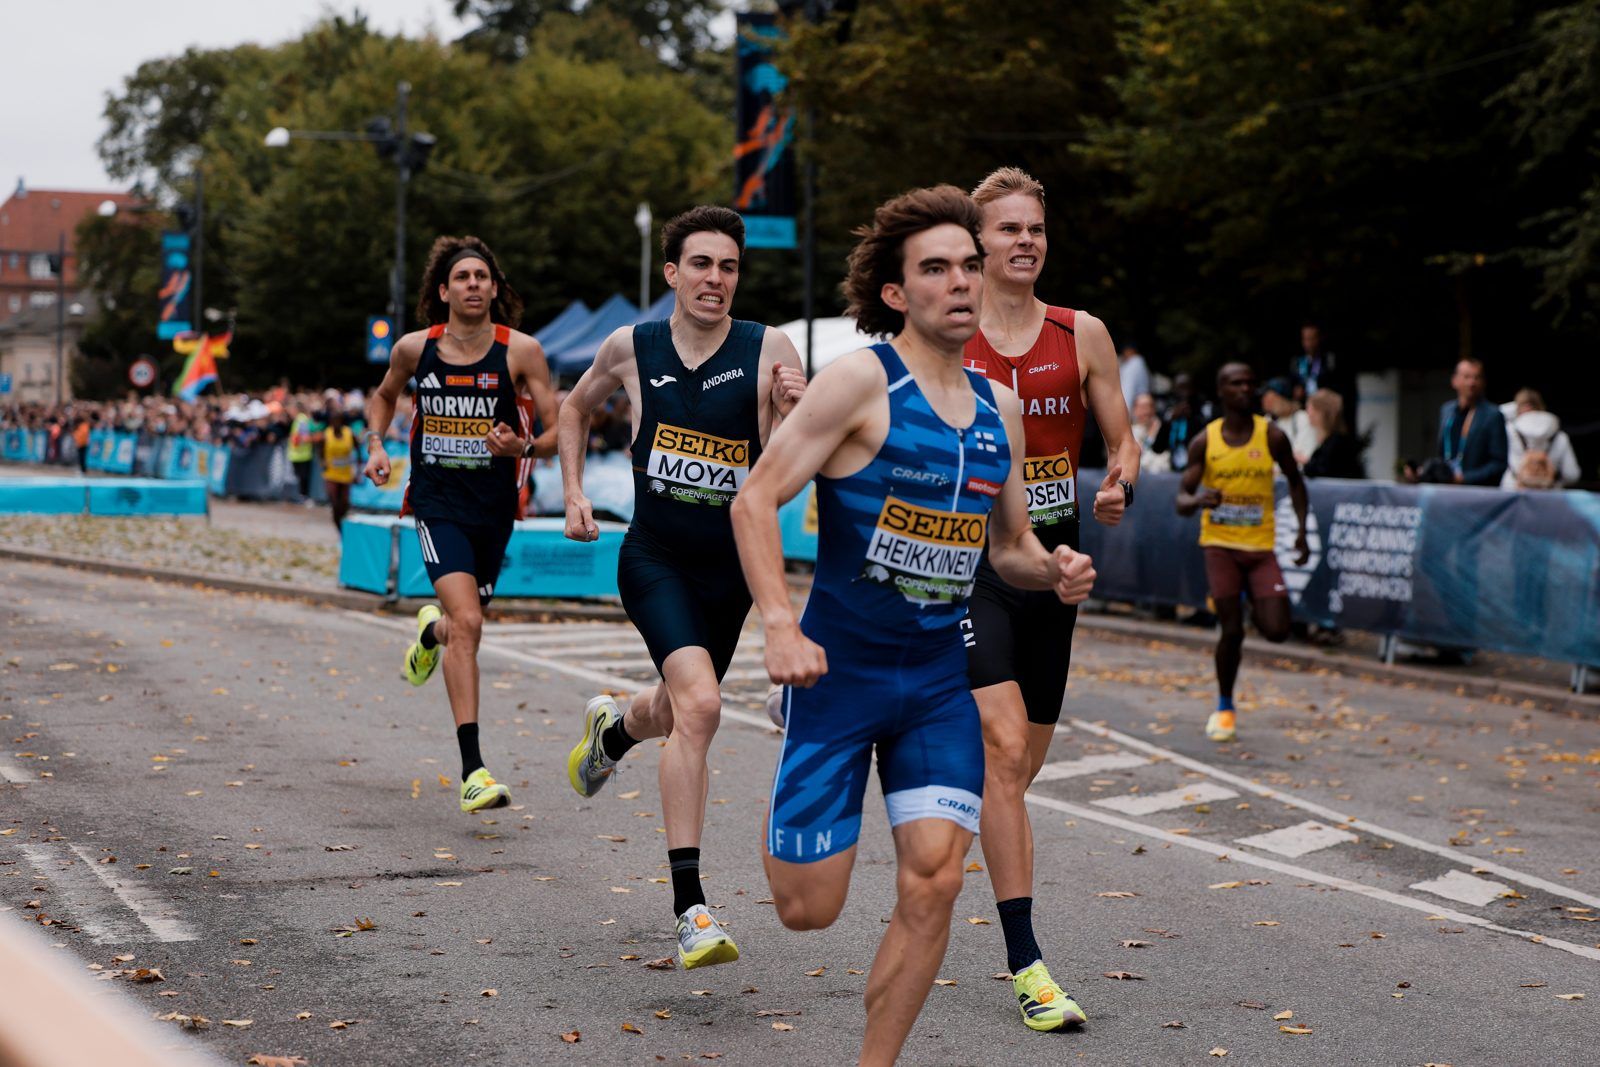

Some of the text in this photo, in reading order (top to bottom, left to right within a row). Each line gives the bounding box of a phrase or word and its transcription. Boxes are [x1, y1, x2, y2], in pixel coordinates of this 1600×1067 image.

[702, 368, 745, 391] ANDORRA
[1028, 364, 1052, 374] CRAFT
[420, 395, 498, 417] NORWAY
[425, 418, 491, 436] SEIKO
[425, 437, 489, 454] BOLLERØD
[656, 429, 746, 464] SEIKO
[657, 455, 737, 488] MOYA
[891, 467, 940, 484] CRAFT
[1023, 458, 1070, 481] IKO
[670, 486, 729, 502] COPENHAGEN
[883, 503, 983, 544] SEIKO
[1029, 511, 1062, 524] NHAGEN
[873, 533, 977, 576] HEIKKINEN
[895, 575, 961, 595] COPENHAGEN
[775, 828, 832, 857] FIN
